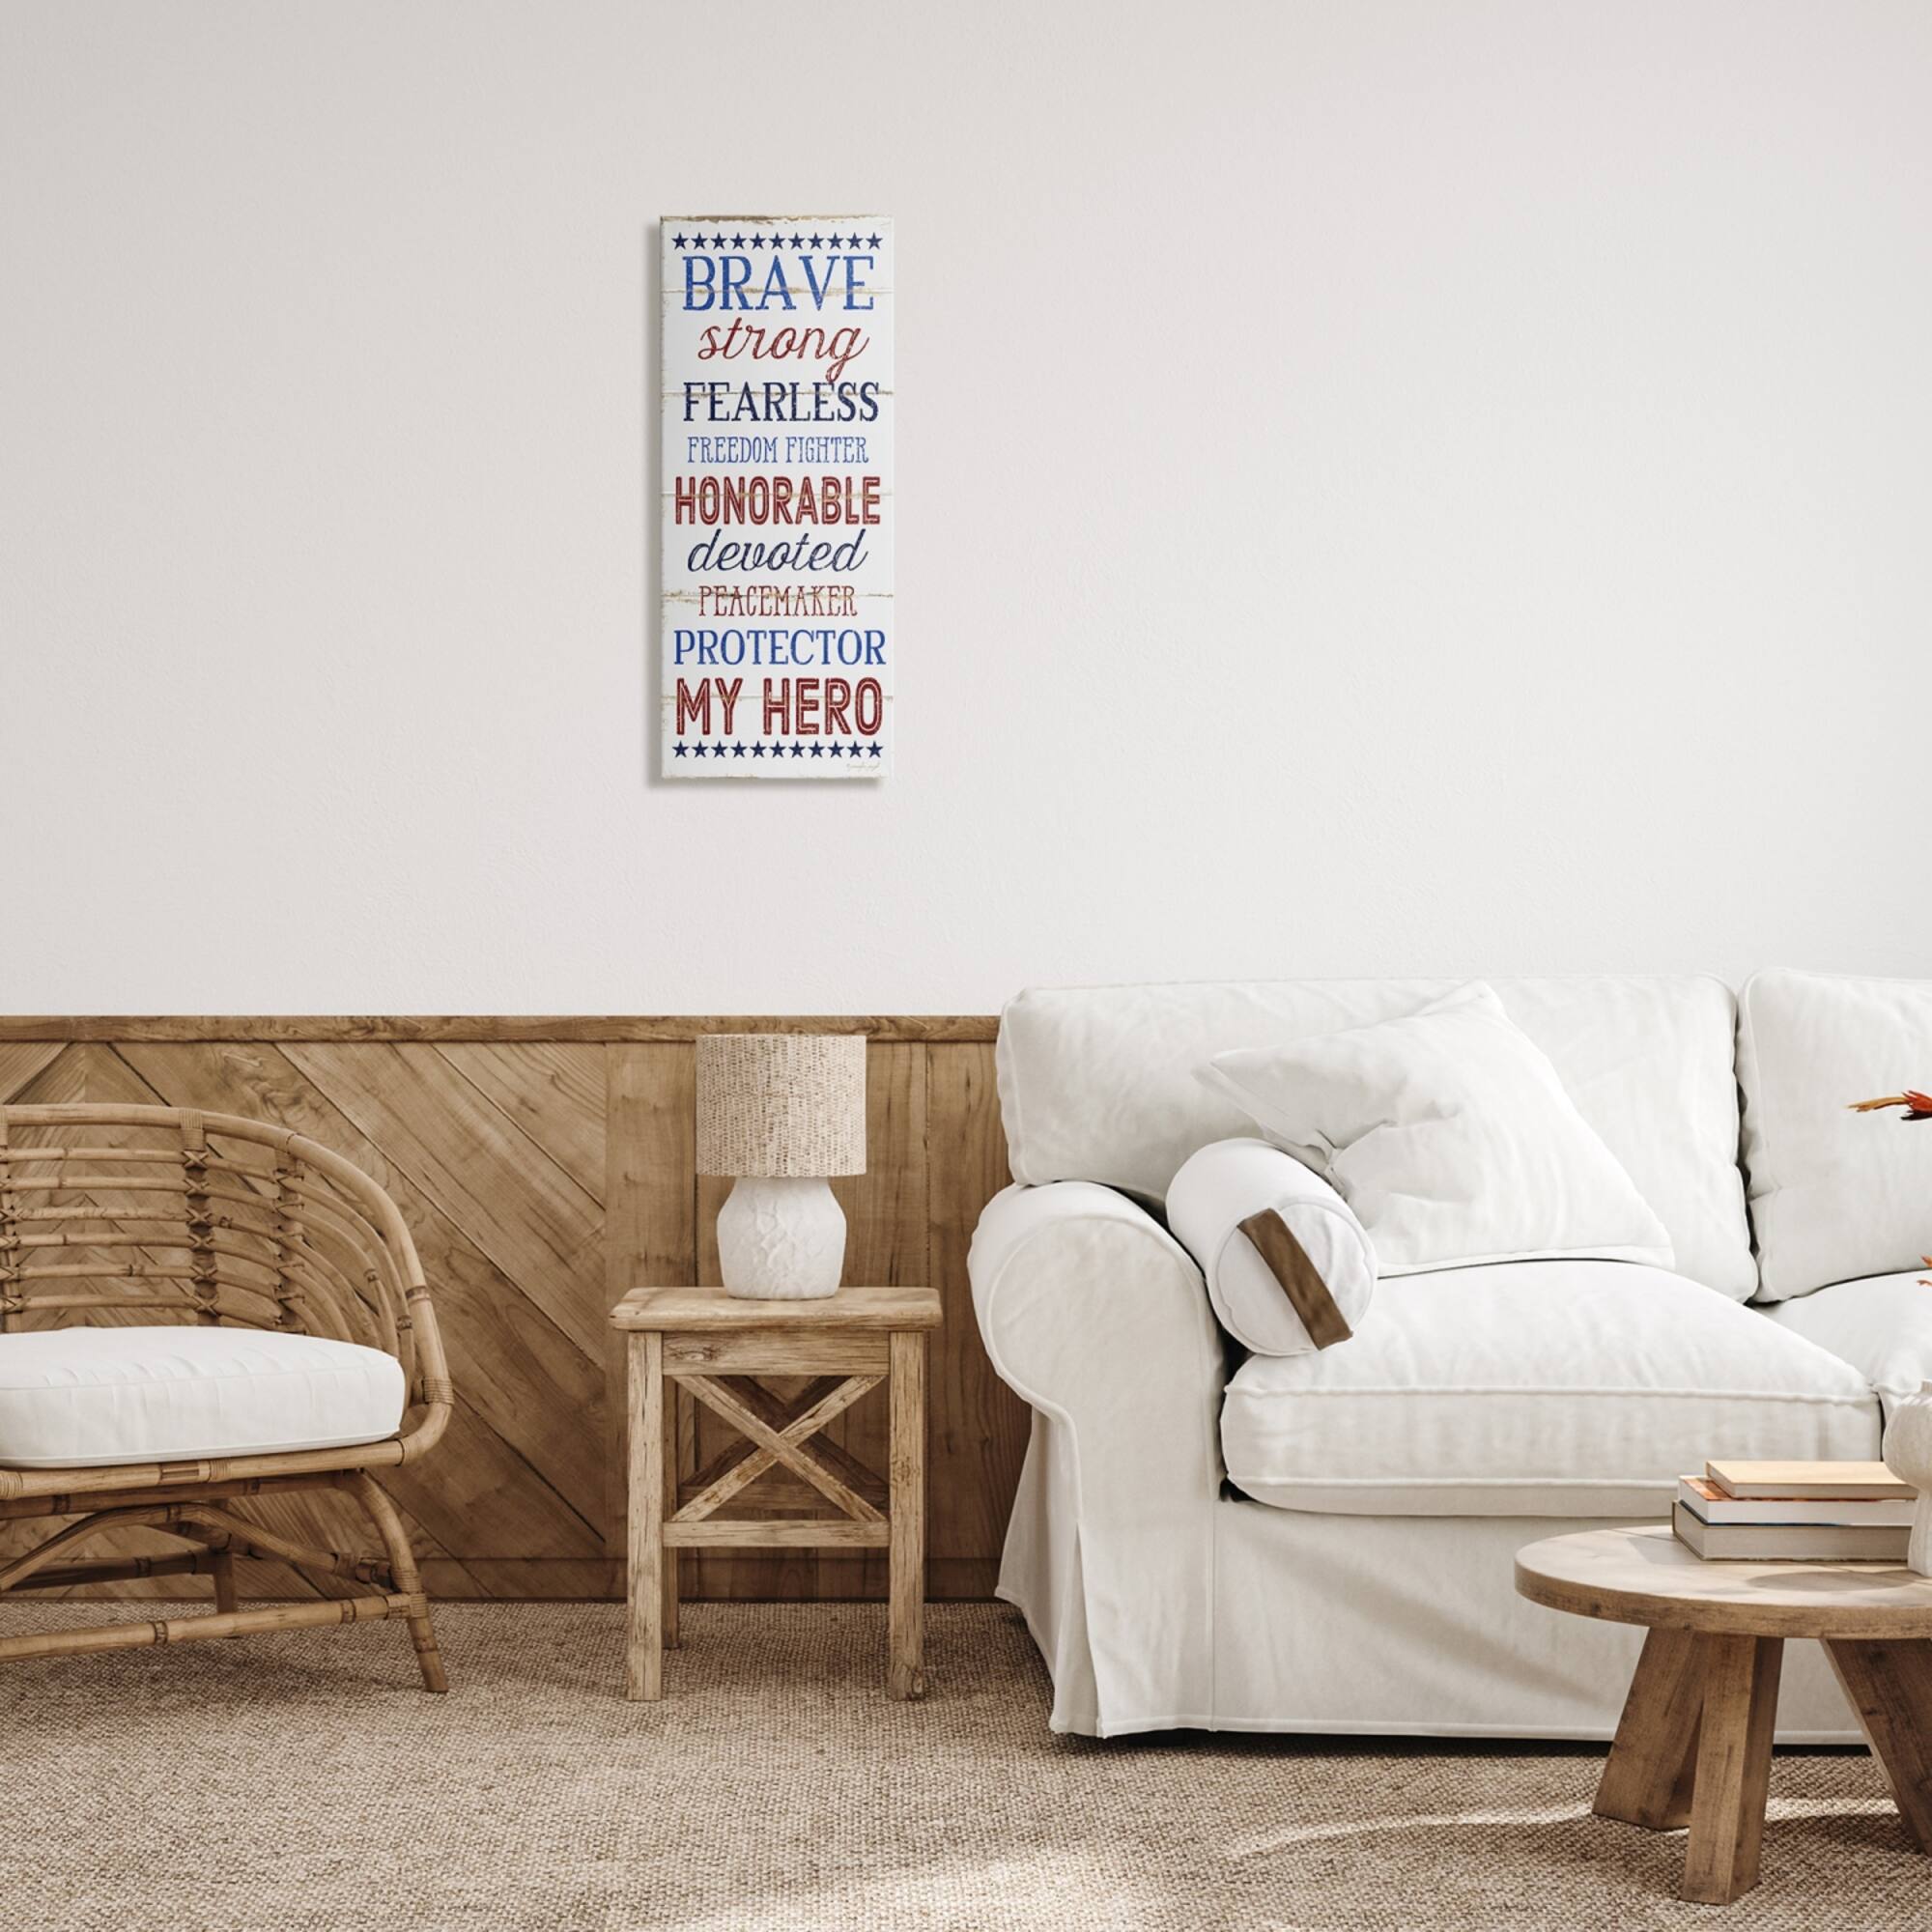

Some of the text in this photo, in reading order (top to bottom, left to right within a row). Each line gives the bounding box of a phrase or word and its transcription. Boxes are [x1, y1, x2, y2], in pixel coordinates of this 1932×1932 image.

[682, 255, 874, 311] BRAVE
[697, 316, 870, 384] strong
[683, 381, 880, 422] FEARLESS
[687, 436, 869, 464] FREEDOM FIGHTER
[675, 475, 881, 526] HONORABLE
[687, 527, 869, 572] devoted
[698, 584, 858, 617] PEACEMAKER
[673, 629, 887, 666] PROTECTOR
[676, 677, 883, 736] MY HERO
